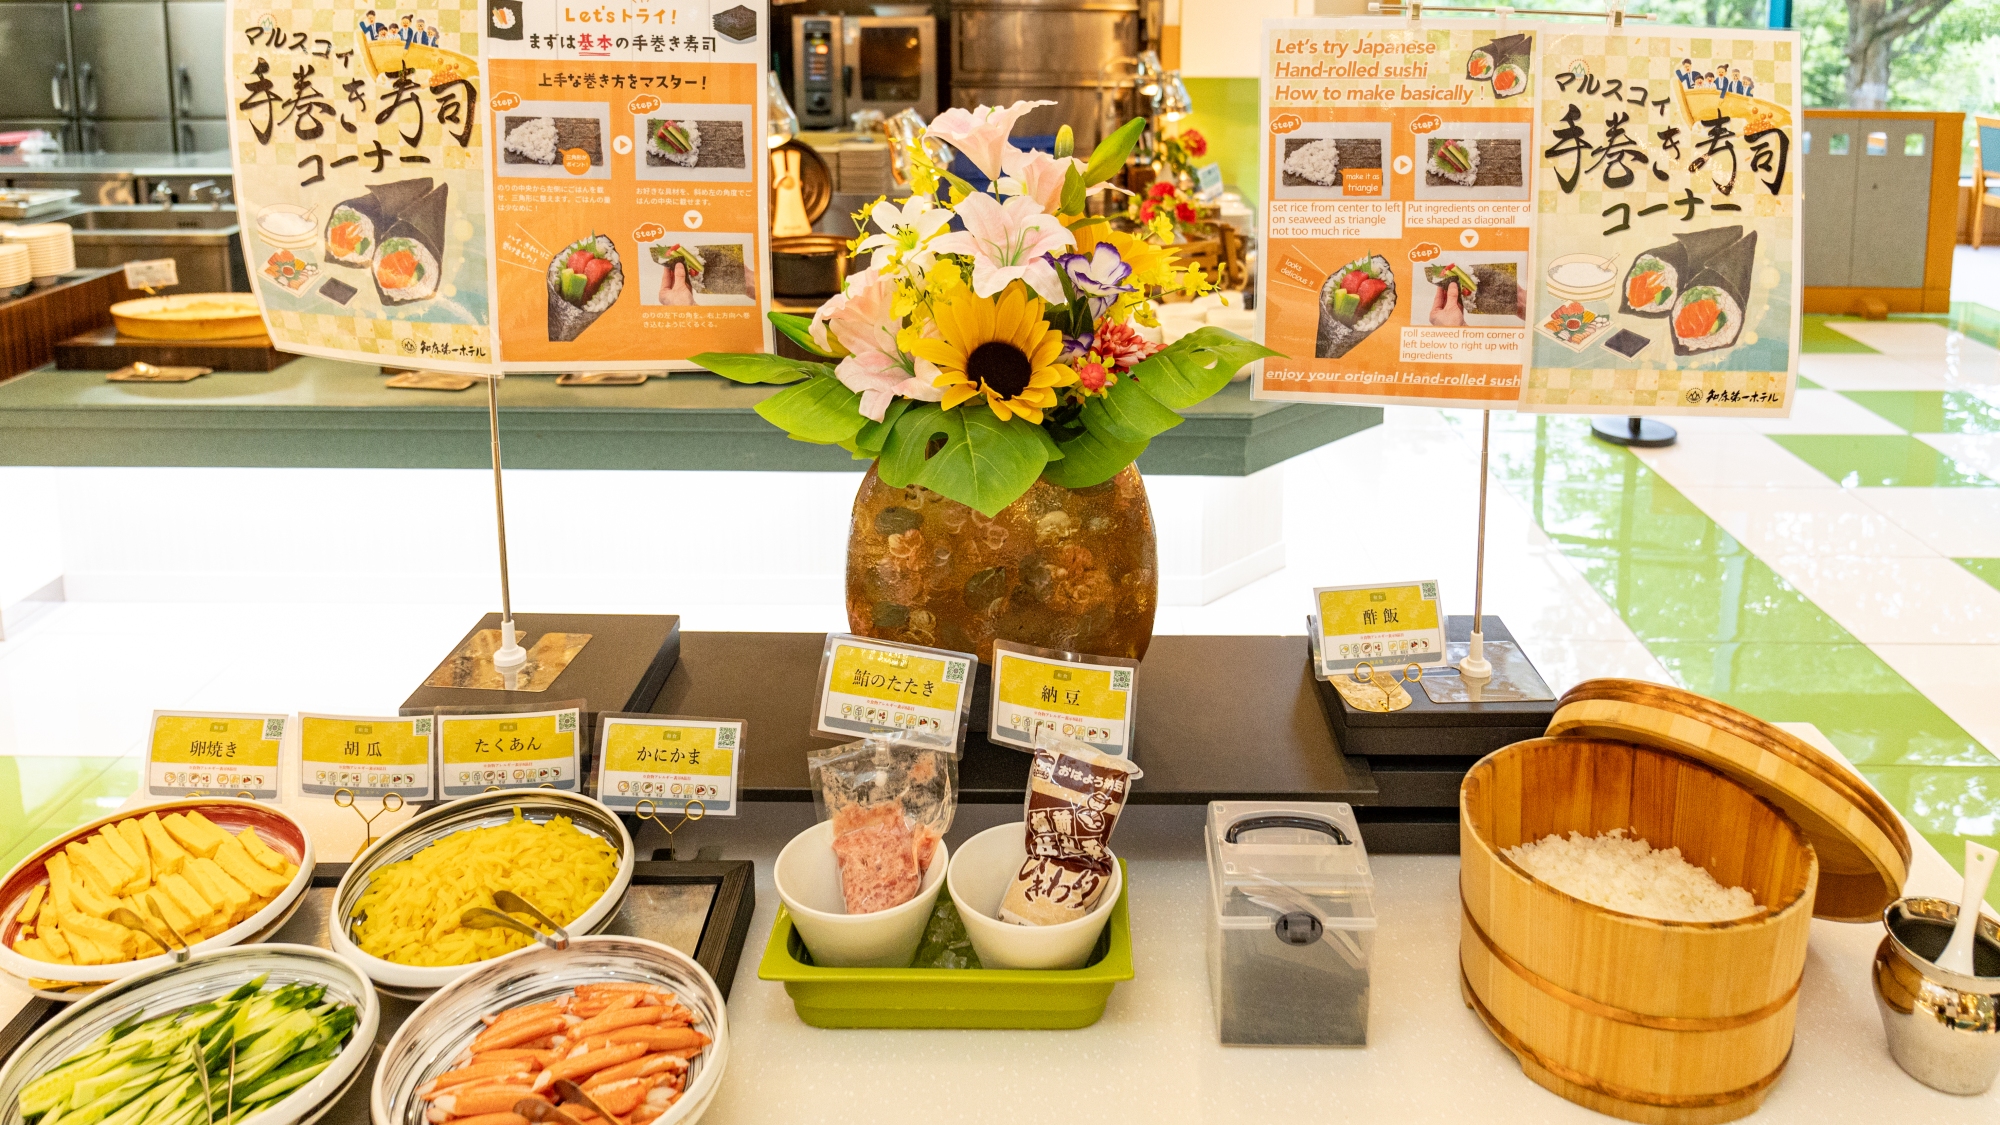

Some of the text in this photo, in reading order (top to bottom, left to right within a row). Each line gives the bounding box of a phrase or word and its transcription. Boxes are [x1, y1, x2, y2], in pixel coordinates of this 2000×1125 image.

[529, 33, 717, 53] まずは基本の手巻き寿司
[1275, 38, 1436, 58] Let's try Japanese
[1274, 61, 1428, 78] Hand-rolled sushi
[239, 57, 478, 148] 手巻き寿司
[492, 96, 519, 108] Step 1
[1274, 85, 1319, 101] How
[1323, 87, 1342, 101] to
[1346, 85, 1395, 101] make
[1400, 85, 1474, 105] basically
[630, 99, 659, 111] Step 2
[1272, 118, 1300, 131] Step 1
[1412, 119, 1440, 131] Step 2
[1544, 103, 1790, 195] 手巻き寿司
[297, 140, 431, 187] コーナー
[1348, 183, 1379, 194] triangle
[1272, 203, 1401, 212] set rice from center to left
[1408, 204, 1422, 212] Put
[1425, 204, 1475, 214] ingredients
[1601, 188, 1742, 237] コーナー
[1272, 215, 1386, 226] on seaweed as triangle
[1408, 216, 1424, 224] rice
[1426, 216, 1460, 226] shaped
[1474, 216, 1515, 226] diagonall
[635, 227, 663, 240] Step 3
[1272, 226, 1360, 235] not too much rice
[1411, 249, 1433, 258] Step
[1285, 258, 1303, 272] looks
[1281, 267, 1308, 285] delicious
[1403, 329, 1418, 338] roll
[1420, 330, 1460, 338] seaweed
[1462, 330, 1484, 339] from
[1486, 331, 1516, 339] corner
[1403, 340, 1417, 348] left
[1420, 340, 1447, 349] below
[1461, 341, 1482, 351] right
[1485, 343, 1497, 352] up
[1499, 342, 1518, 350] with
[1402, 351, 1453, 360] ingredients
[1266, 369, 1305, 382] enjoy
[1307, 371, 1341, 382] your
[1344, 371, 1398, 385] original
[1402, 372, 1487, 386] Hand-rolled
[1362, 607, 1399, 625] 酢飯
[852, 668, 935, 698] 鮪のたたき
[1041, 684, 1081, 706] 納豆
[190, 740, 237, 758] 卵焼き
[344, 741, 382, 757] 胡瓜
[475, 737, 542, 753] たくあん
[636, 746, 701, 765] かにかま
[1057, 765, 1125, 794] おはよう納豆
